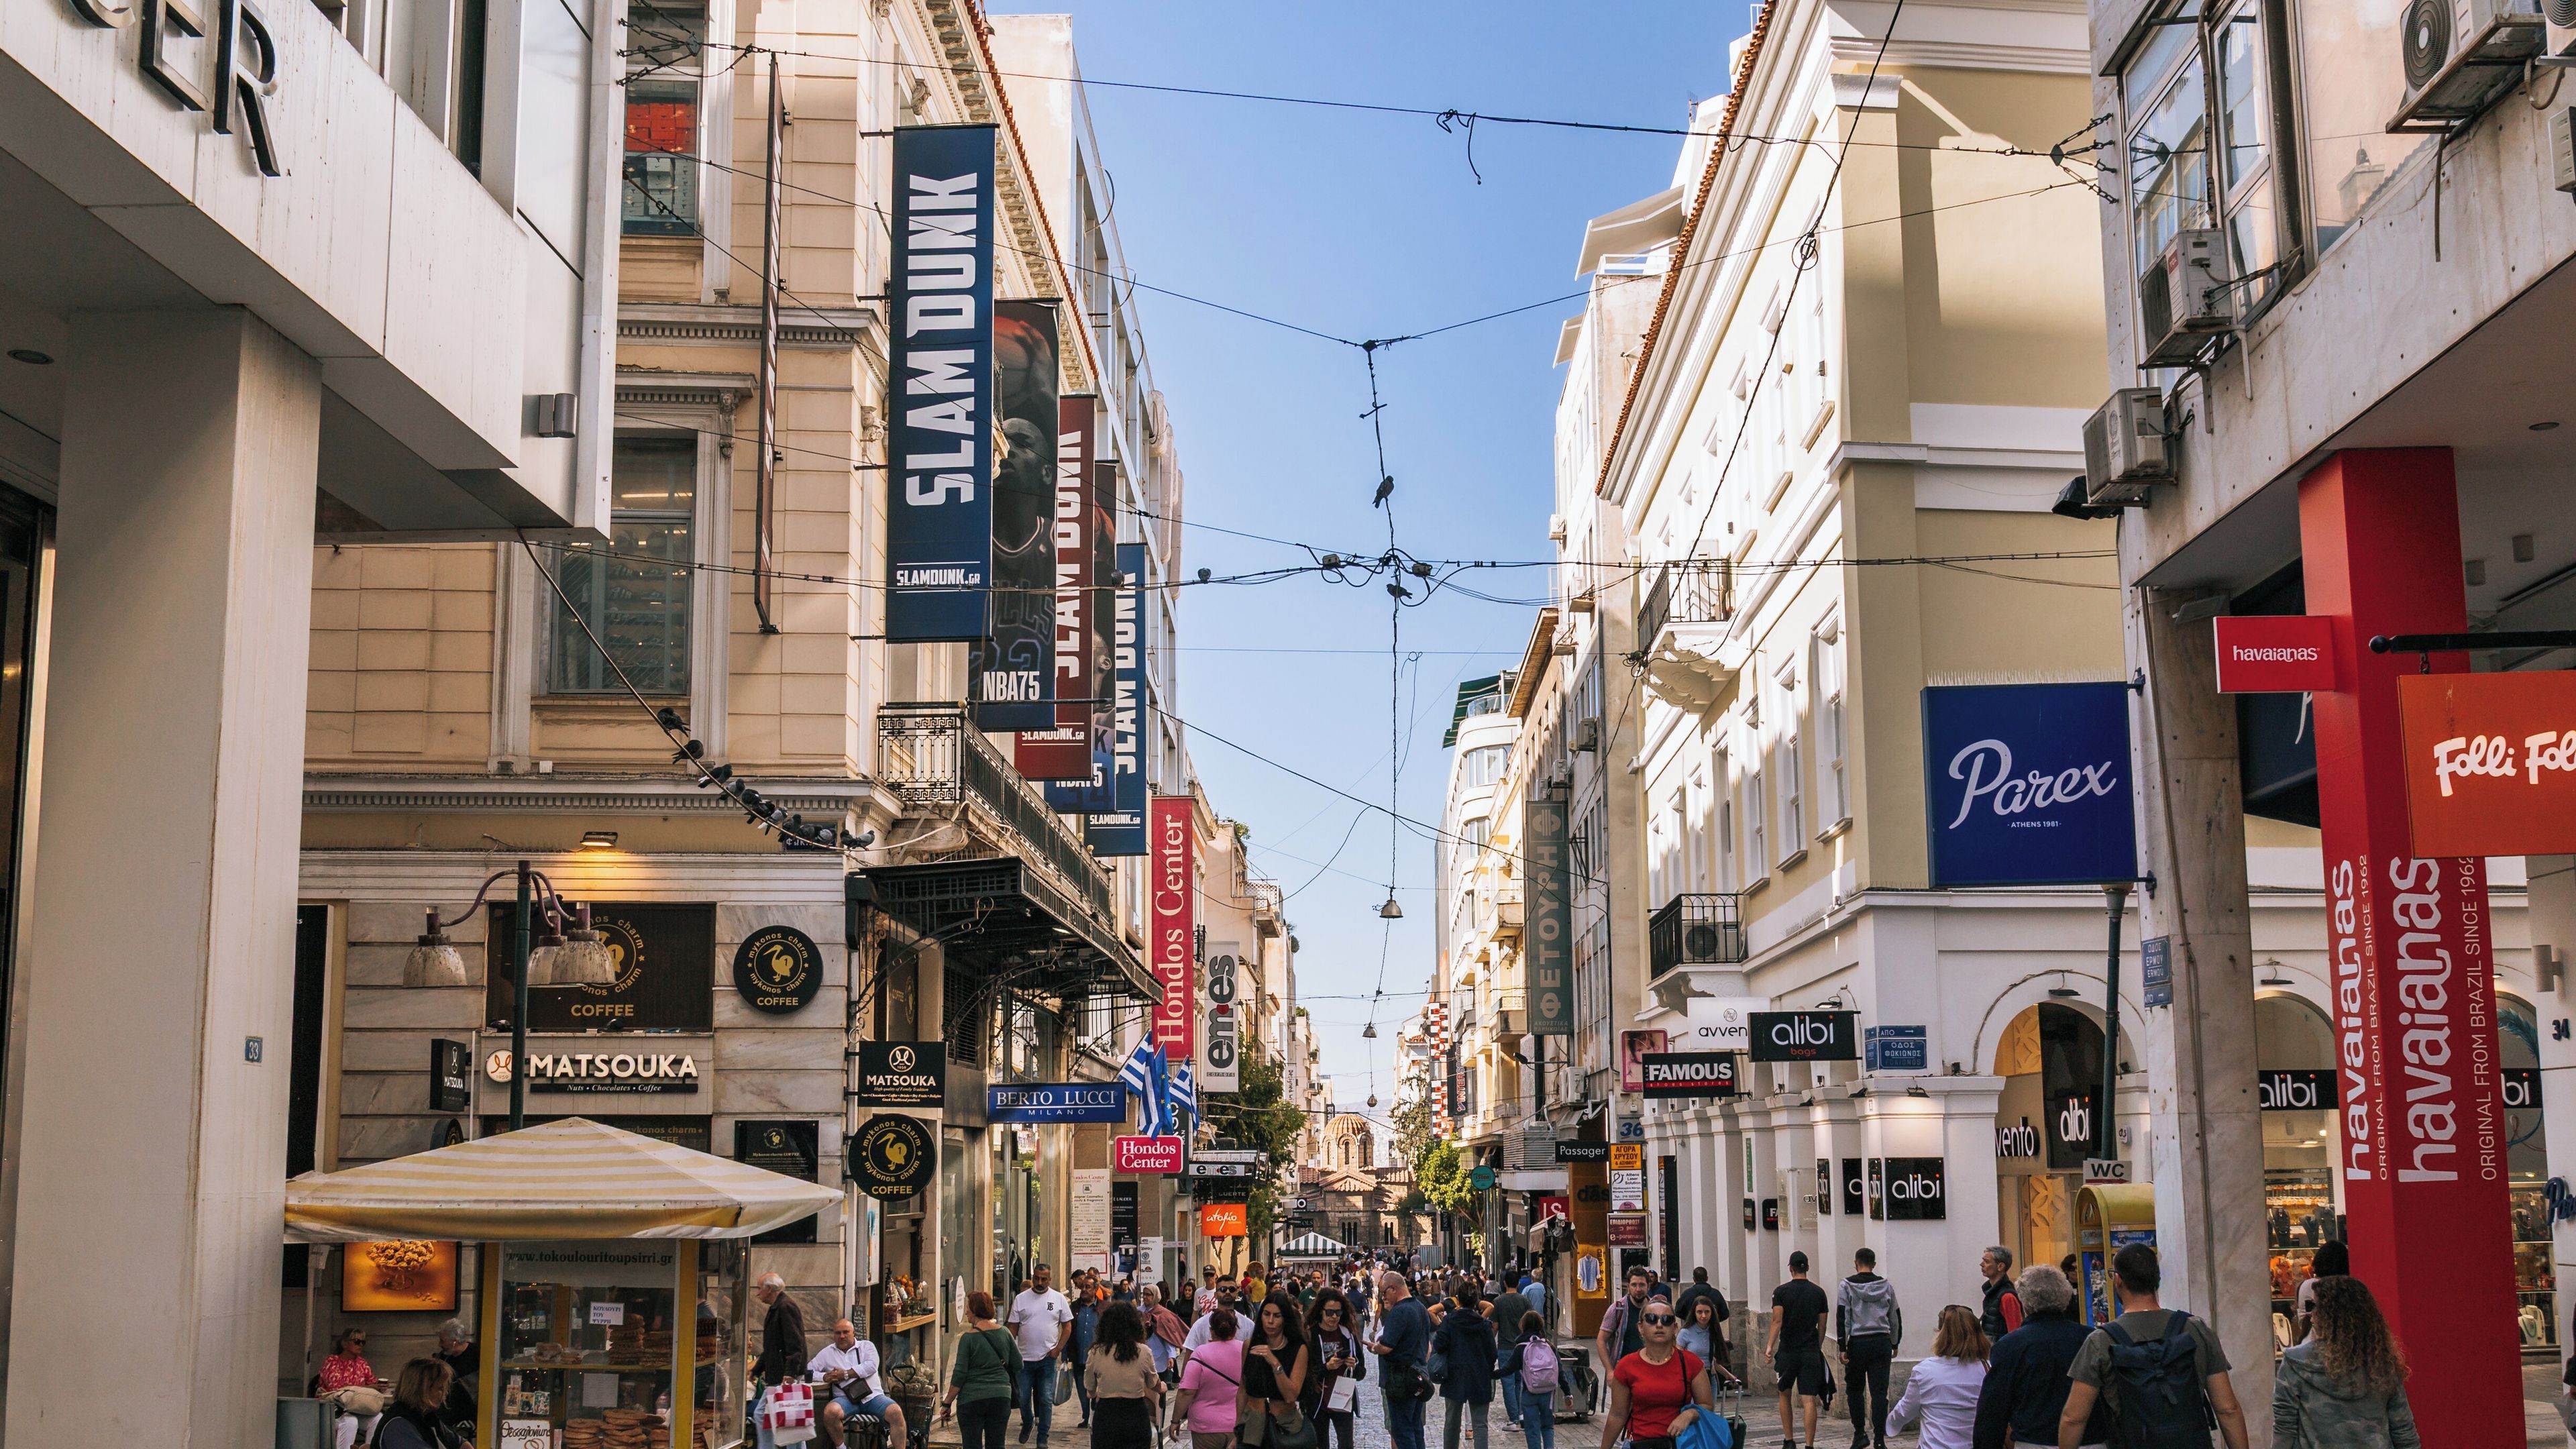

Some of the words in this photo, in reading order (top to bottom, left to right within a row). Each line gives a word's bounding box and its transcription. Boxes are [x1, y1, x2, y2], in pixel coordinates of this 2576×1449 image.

[72, 0, 280, 176] ER
[907, 172, 977, 338] DUNK
[906, 350, 975, 506] SLAM
[896, 568, 981, 587] SLAMDUNK.GR
[2233, 645, 2318, 663] havaianas
[983, 671, 1040, 701] NBA75
[2433, 735, 2518, 797] Folli
[2524, 730, 2576, 785] Fol
[1948, 739, 2117, 830] Parex
[1089, 814, 1140, 825] SLAMDUNK.GR
[1155, 814, 1183, 916] Center
[2359, 854, 2369, 896] 1962
[617, 919, 644, 949] charm
[2363, 902, 2374, 957] SINCE
[2463, 901, 2481, 955] SINCE
[749, 933, 782, 959] mykonos
[788, 935, 808, 959] charm
[614, 967, 642, 993] charm
[750, 973, 782, 994] mykonos
[786, 972, 807, 991] charm
[1157, 928, 1184, 1044] Hondos
[757, 998, 799, 1006] COFFEE
[2367, 965, 2379, 1029] BRAZIL
[2467, 960, 2485, 1028] BRAZIL
[571, 1004, 634, 1017] COFFEE
[2332, 859, 2372, 1181] havaianas
[2389, 856, 2459, 1183] havaianas
[1771, 1014, 1834, 1046] alibi
[2552, 1018, 2571, 1041] 34
[248, 1041, 259, 1061] 33
[1790, 1047, 1817, 1057] bags
[2372, 1035, 2382, 1086] FROM
[2472, 1033, 2491, 1086] FROM
[529, 1054, 698, 1078] MATSOUKA
[1648, 1063, 1733, 1081] FAMOUS
[638, 1084, 662, 1093] Coffee
[866, 1075, 936, 1087] MATSOUKA
[996, 1091, 1053, 1106] BERTO
[1065, 1090, 1115, 1104] LUCCI
[1620, 1122, 1644, 1137] 36
[2060, 1097, 2090, 1141] alibi
[863, 1121, 896, 1147] mykonos
[902, 1123, 922, 1146] charm
[2375, 1091, 2387, 1181] ORIGINAL
[2477, 1091, 2496, 1181] ORIGINAL
[1122, 1140, 1177, 1155] Hondos
[1560, 1145, 1605, 1158] Passager
[864, 1161, 896, 1182] mykonos
[900, 1160, 920, 1180] charm
[1122, 1154, 1171, 1169] Center
[2090, 1163, 2125, 1178] WC
[871, 1185, 913, 1194] COFFEE
[1892, 1173, 1941, 1199] alibi
